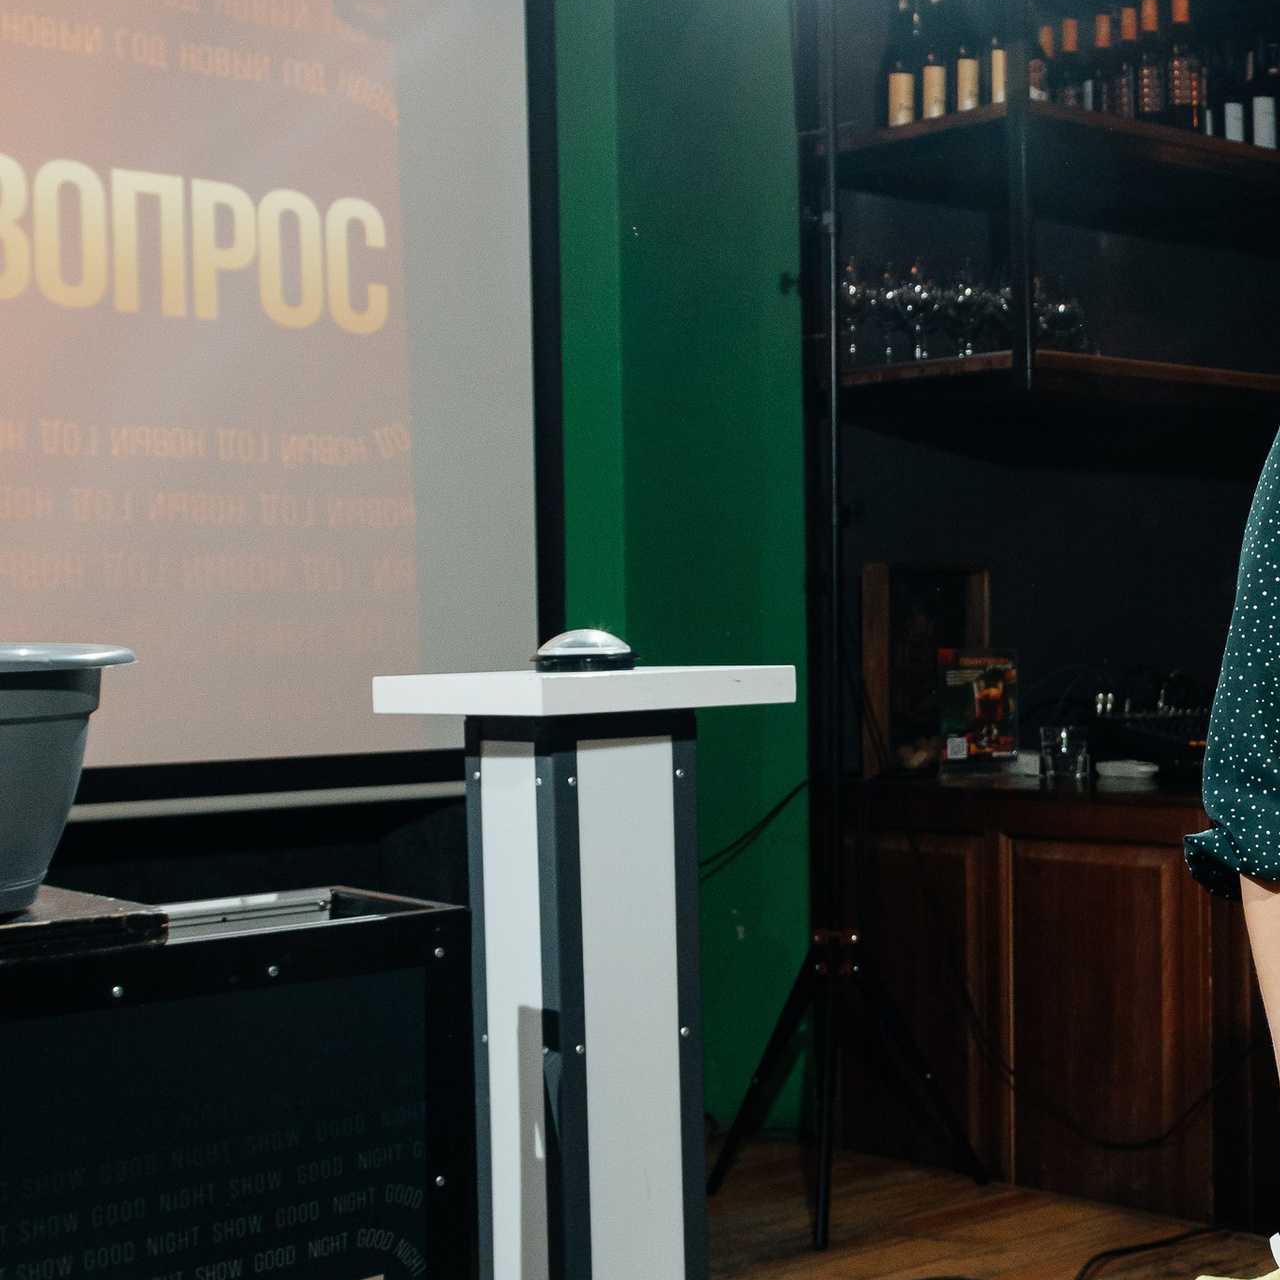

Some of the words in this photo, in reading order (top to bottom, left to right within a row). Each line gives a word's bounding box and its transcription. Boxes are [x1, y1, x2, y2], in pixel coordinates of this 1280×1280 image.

[0, 153, 389, 335] ВОПРОС
[83, 1241, 135, 1272] GOOD
[146, 1225, 199, 1257] NIGHT
[212, 1214, 263, 1243] SHOW
[275, 1200, 320, 1229] GOOD
[333, 1186, 376, 1215] NIGHT
[384, 1183, 424, 1210] GOOD
[254, 1245, 296, 1273] GOOD
[308, 1231, 348, 1260] NIGHT
[356, 1228, 395, 1251] GOOD
[394, 1238, 427, 1277] NIGHT
